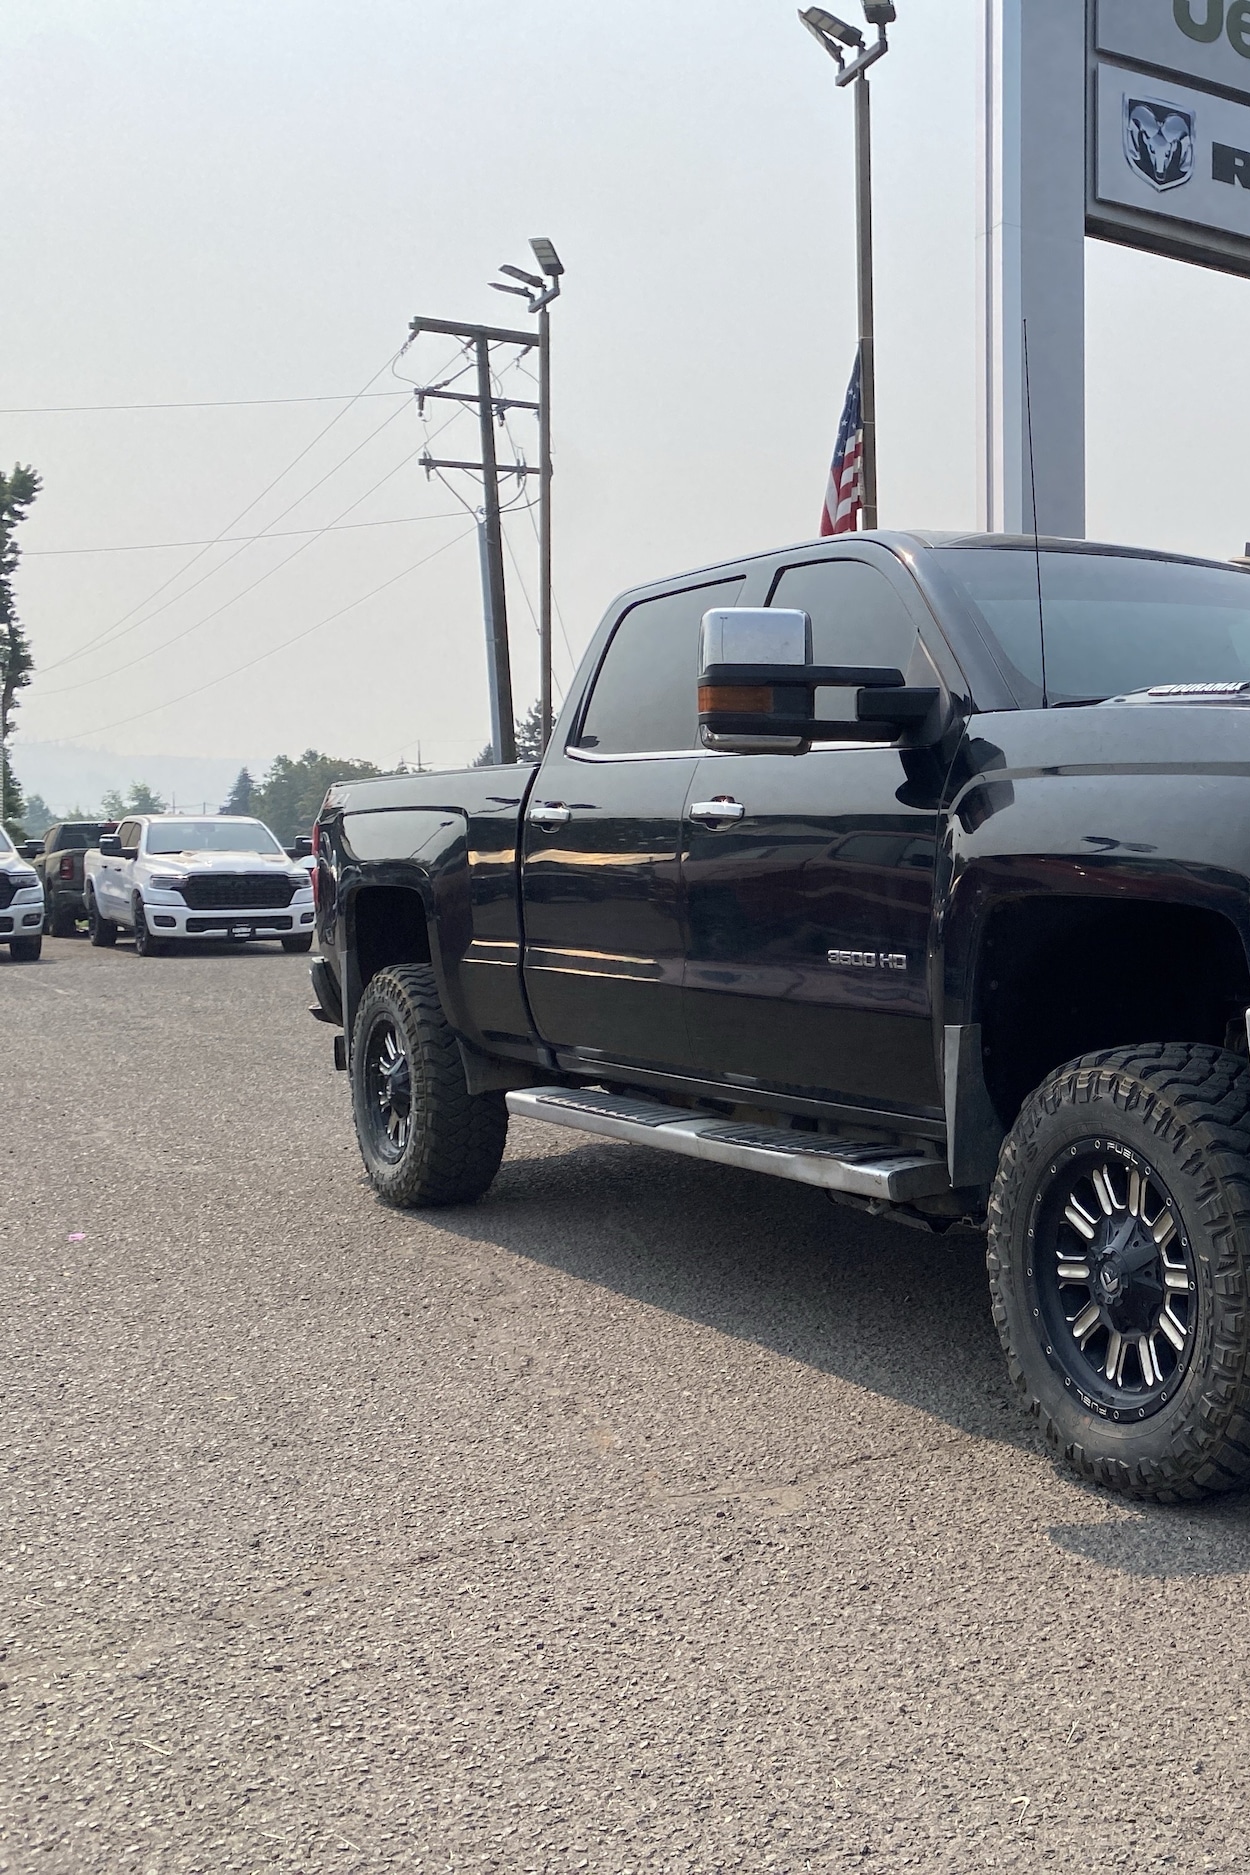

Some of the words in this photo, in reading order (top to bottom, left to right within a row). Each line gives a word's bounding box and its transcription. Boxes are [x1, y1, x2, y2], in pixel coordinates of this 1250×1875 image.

[879, 952, 907, 970] HD
[1106, 1141, 1139, 1165] FUEL
[1076, 1388, 1107, 1416] FUEL
